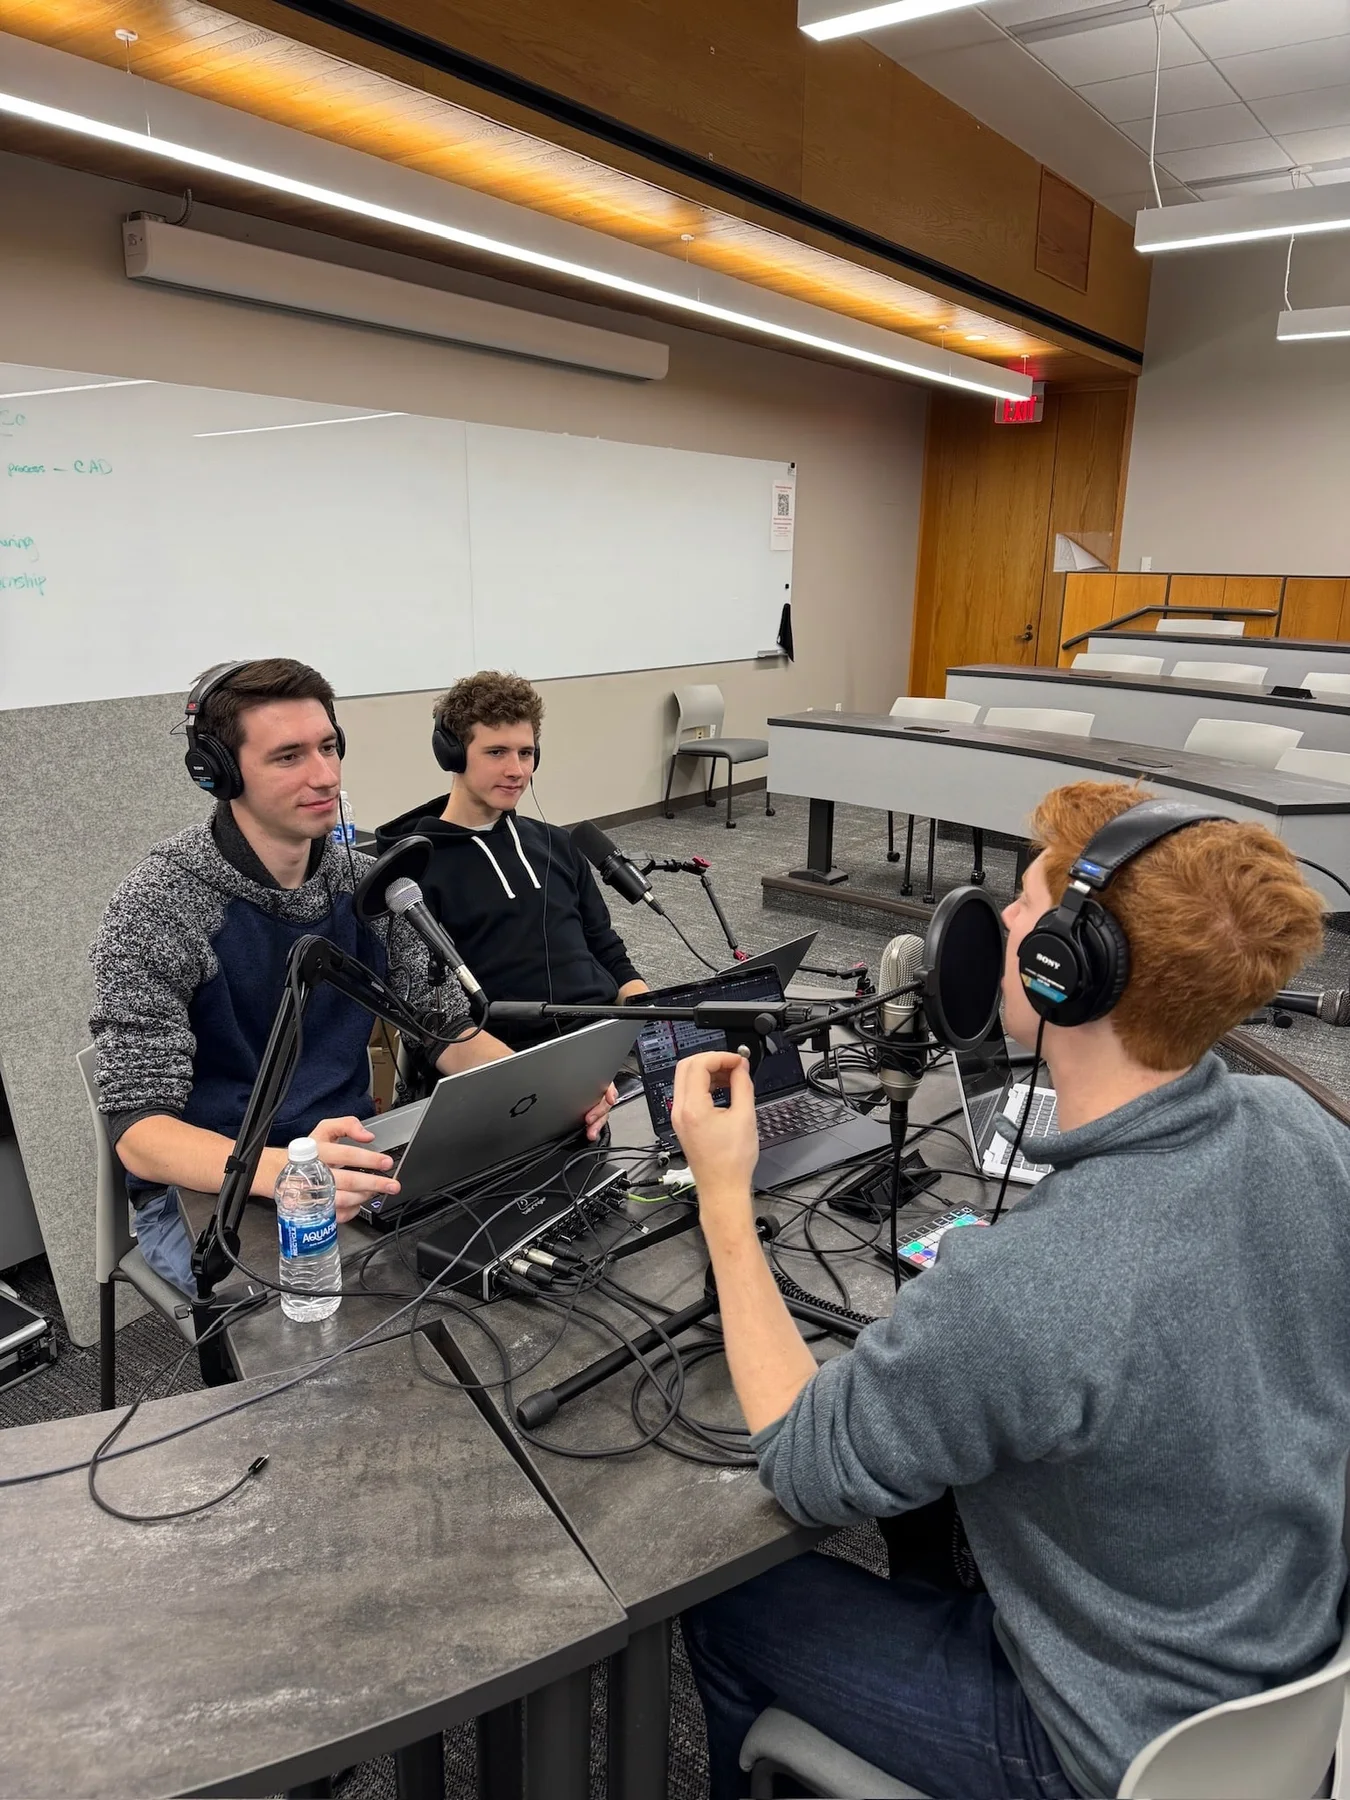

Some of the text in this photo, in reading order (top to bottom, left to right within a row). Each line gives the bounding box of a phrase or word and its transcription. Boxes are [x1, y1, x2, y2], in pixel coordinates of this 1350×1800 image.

[1003, 396, 1037, 422] EXIT
[74, 459, 113, 475] CAD
[1036, 953, 1061, 970] SONY
